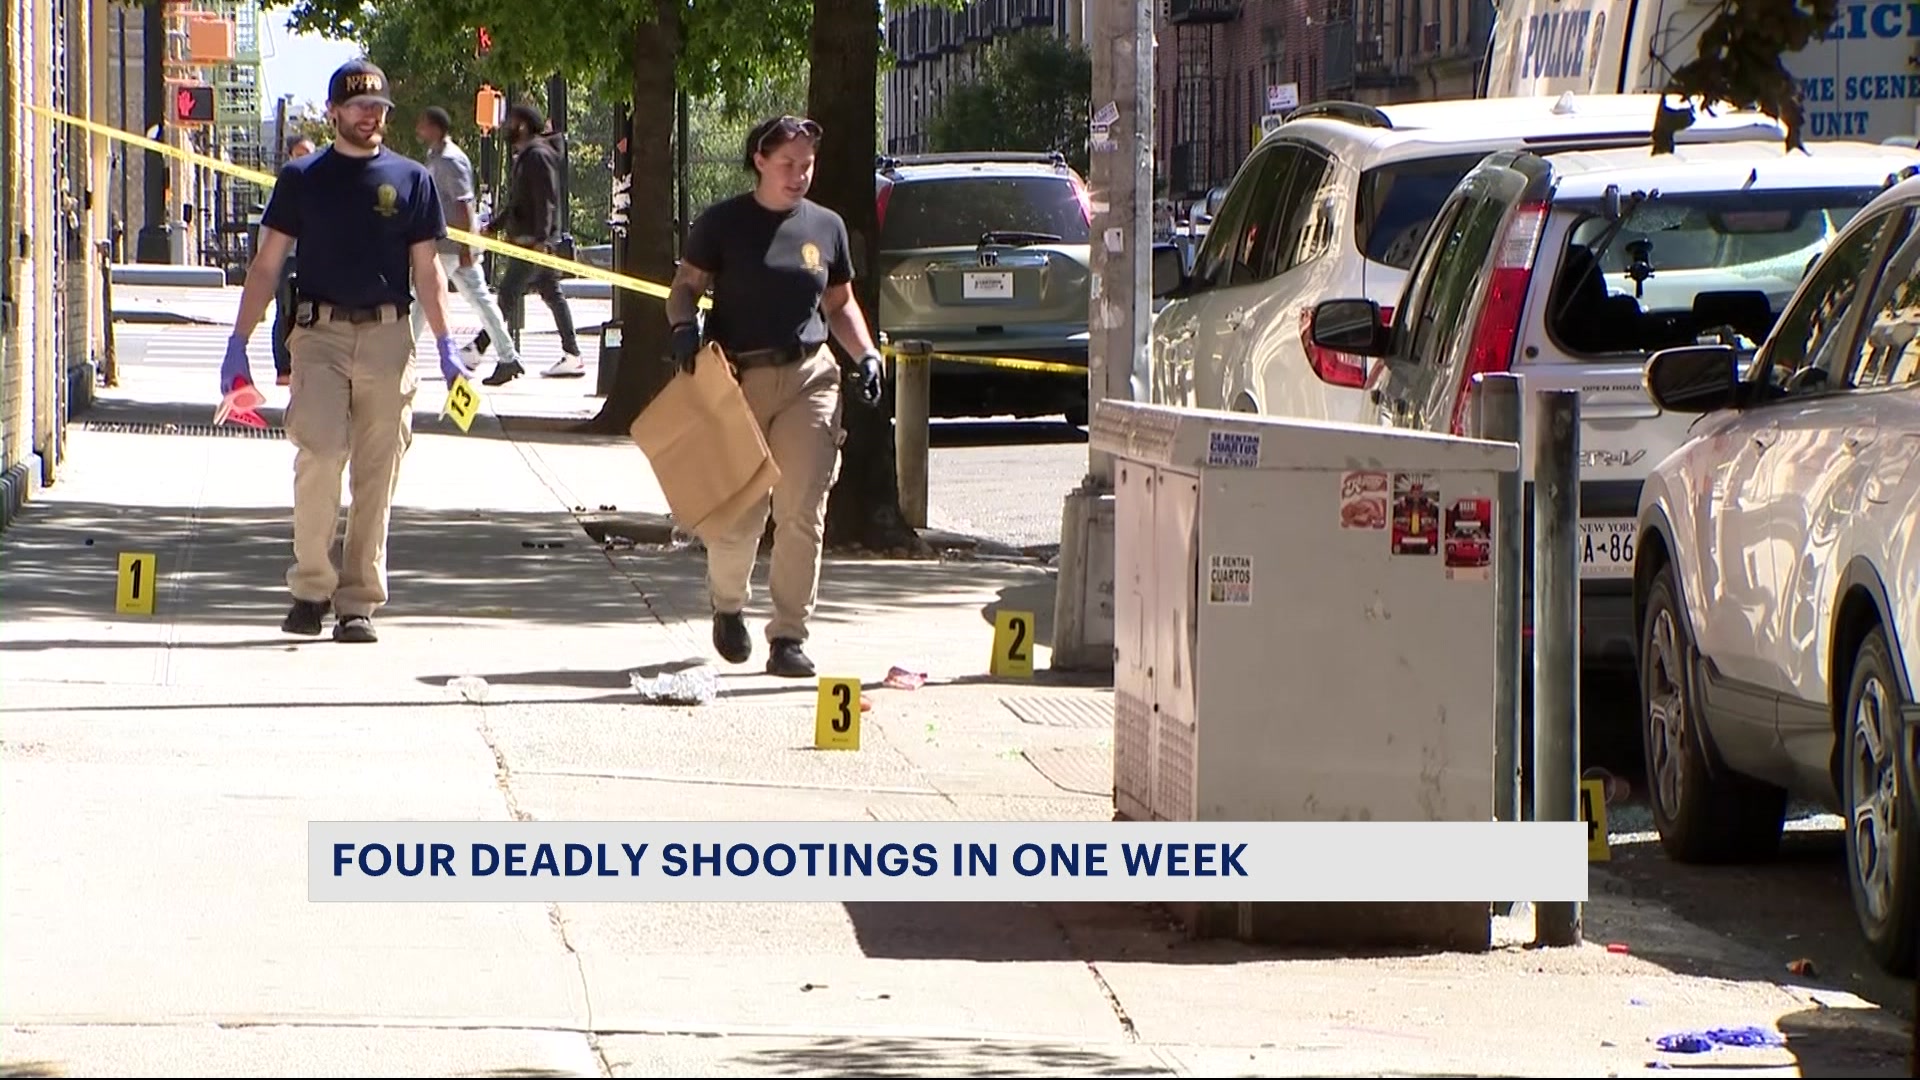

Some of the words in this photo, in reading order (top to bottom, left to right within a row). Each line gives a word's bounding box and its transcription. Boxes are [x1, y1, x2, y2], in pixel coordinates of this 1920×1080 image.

[1521, 9, 1591, 79] POLICE
[1845, 74, 1920, 101] SCENE
[1810, 111, 1869, 137] UNIT
[451, 385, 471, 417] 13
[1210, 442, 1258, 456] CUARTOS
[1580, 523, 1604, 533] NEW
[1607, 523, 1637, 533] YORK
[1212, 556, 1220, 567] SE
[130, 559, 141, 599] 1
[1211, 569, 1250, 584] CUARTOS
[1008, 617, 1026, 662] 2
[831, 683, 851, 733] 3
